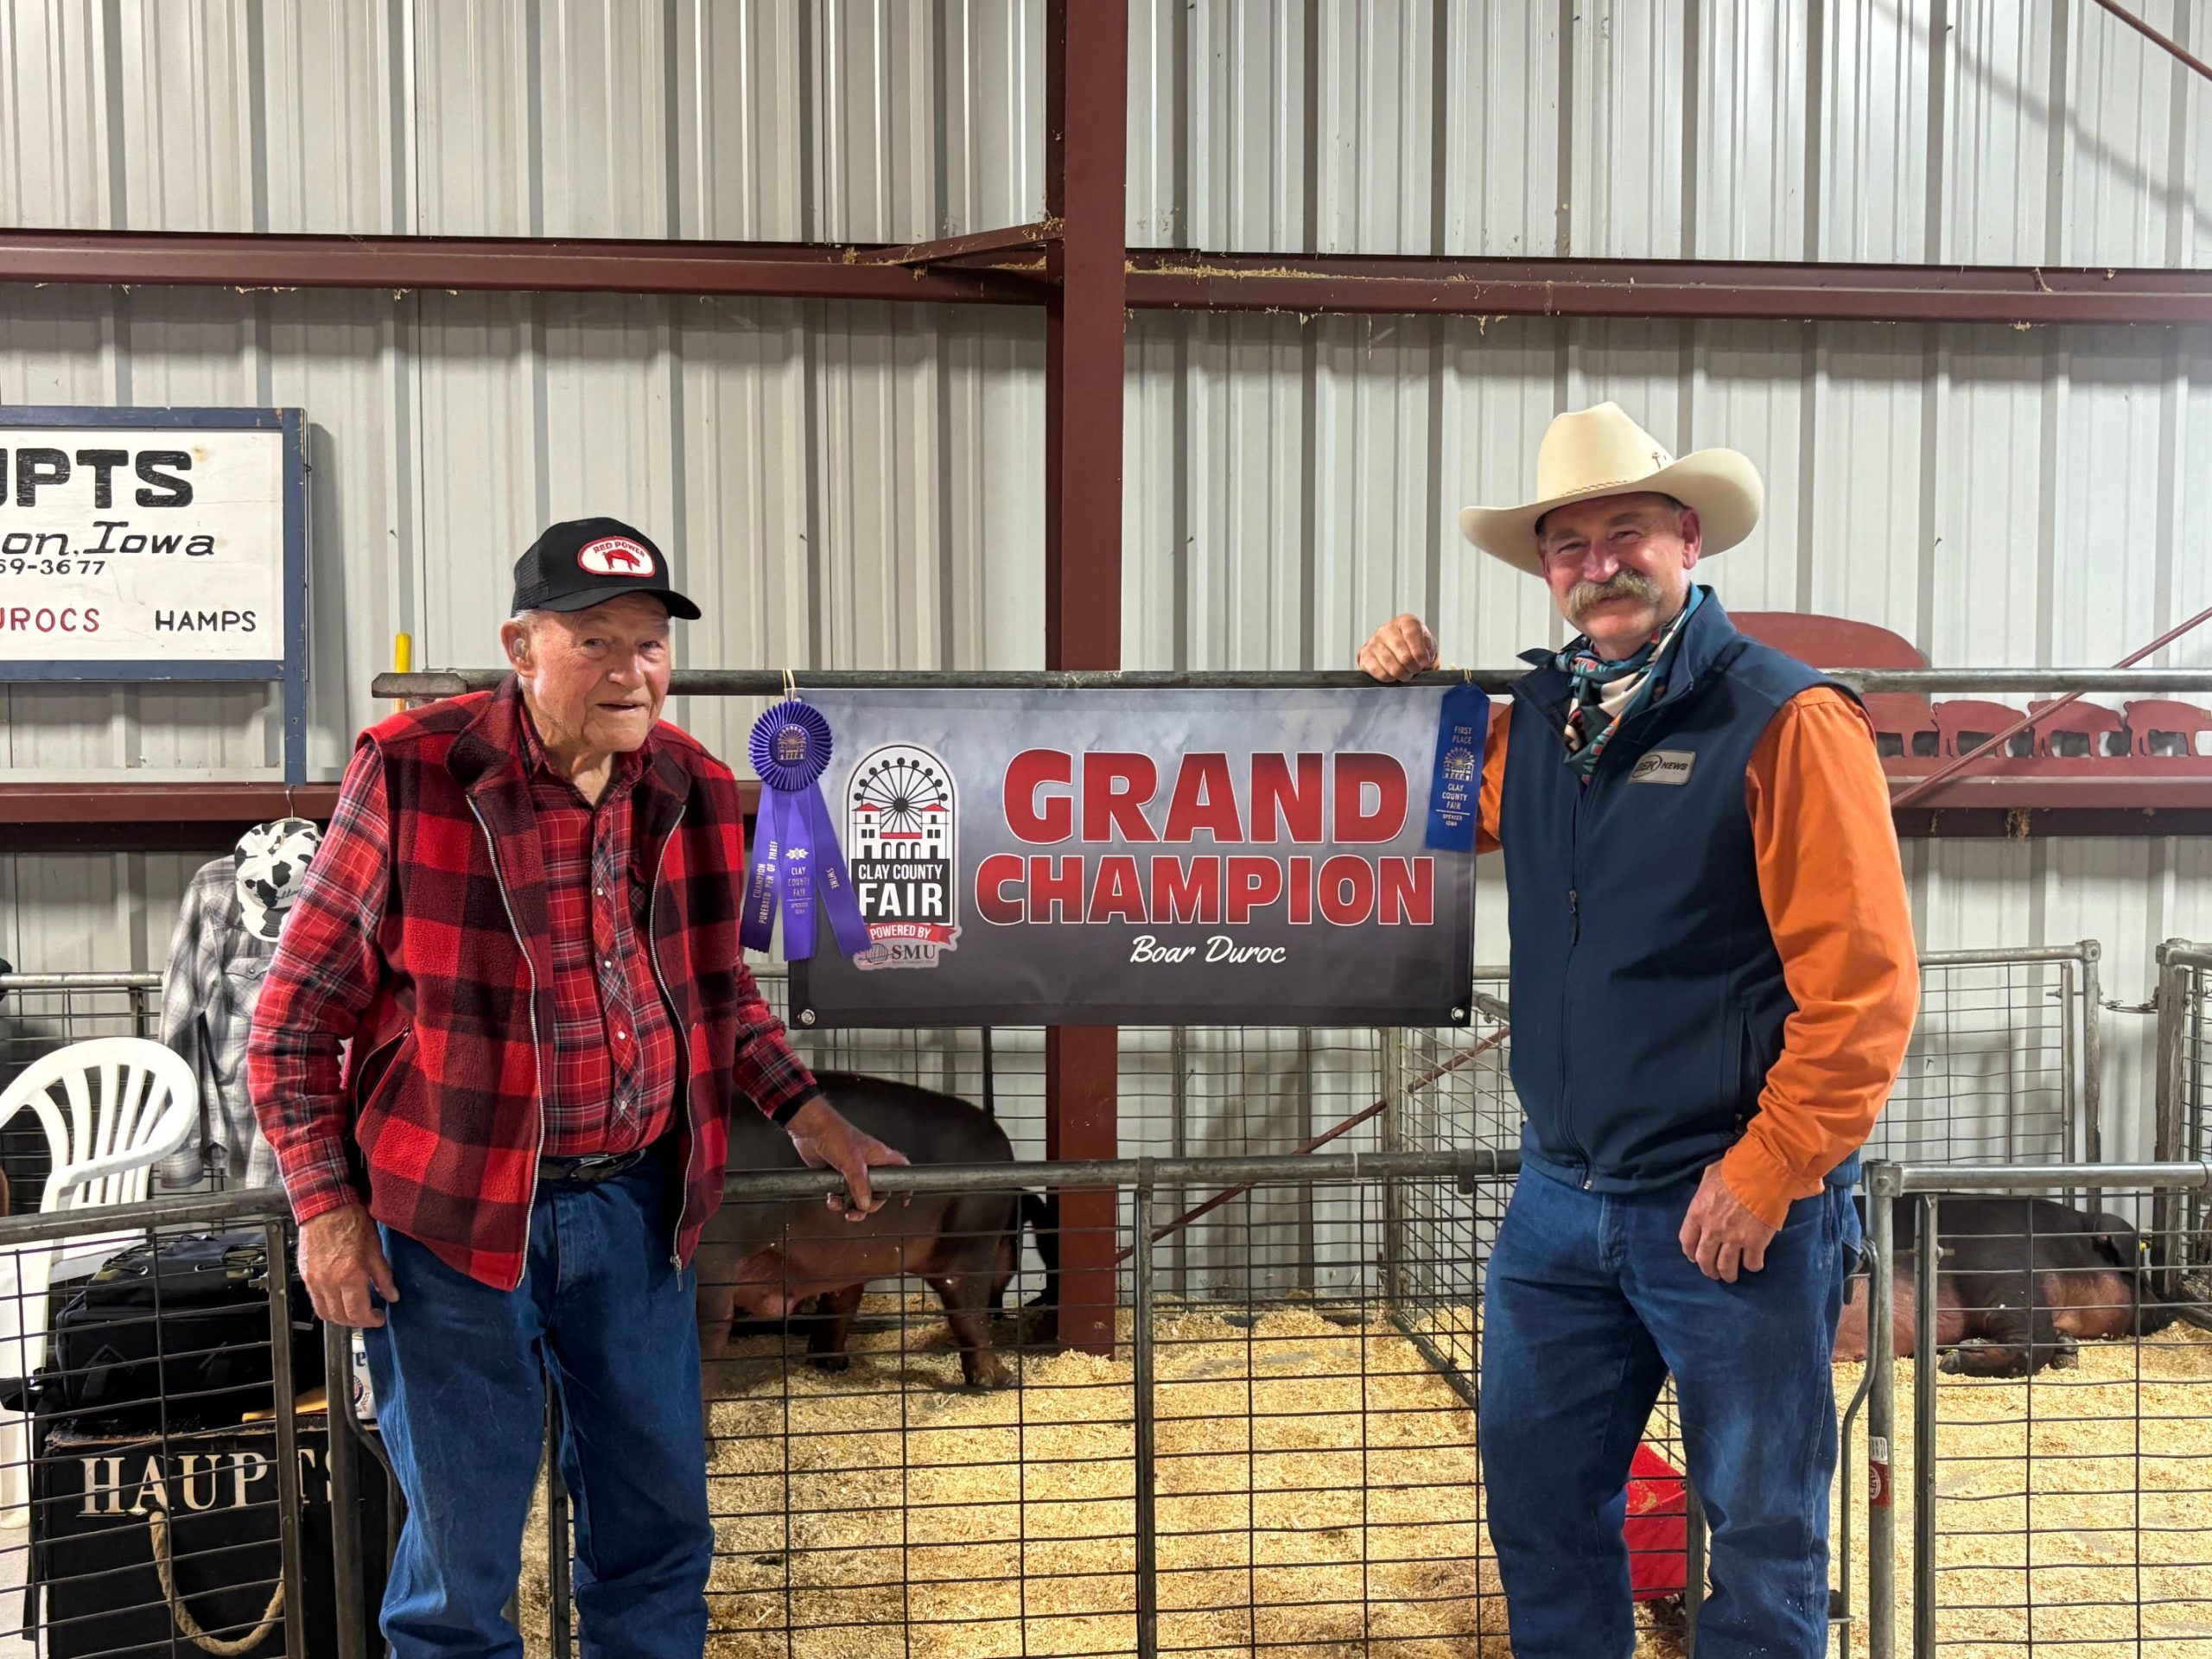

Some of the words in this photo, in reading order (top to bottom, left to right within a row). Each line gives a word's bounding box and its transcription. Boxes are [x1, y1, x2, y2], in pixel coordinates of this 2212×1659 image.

[0, 448, 194, 508] PTS
[82, 520, 215, 556] Iowa
[593, 543, 613, 554] RED
[614, 541, 645, 558] POWER
[0, 607, 100, 632] ROCS
[155, 609, 257, 632] HAMPS
[1453, 725, 1472, 734] FIRST
[1452, 734, 1472, 745] PLACE
[1660, 761, 1688, 771] NEWS
[1447, 783, 1464, 791] CLAY
[1002, 748, 1409, 845] GRAND
[1441, 791, 1468, 801] COUNTY
[1446, 801, 1461, 810] FAIR
[766, 862, 776, 872] OF
[791, 866, 806, 875] CLAY
[858, 864, 890, 880] CLAY
[893, 864, 944, 880] COUNTY
[753, 863, 766, 898] CHAMPION
[787, 877, 810, 887] COUNTY
[825, 868, 839, 889] SWINE
[792, 888, 806, 897] FAIR
[974, 853, 1434, 925] CHAMPION
[859, 882, 943, 916] FAIR
[869, 925, 916, 940] POWERED
[917, 926, 931, 939] BY
[891, 944, 936, 960] SMU
[1129, 935, 1196, 963] Boar
[1205, 935, 1287, 964] Duroc
